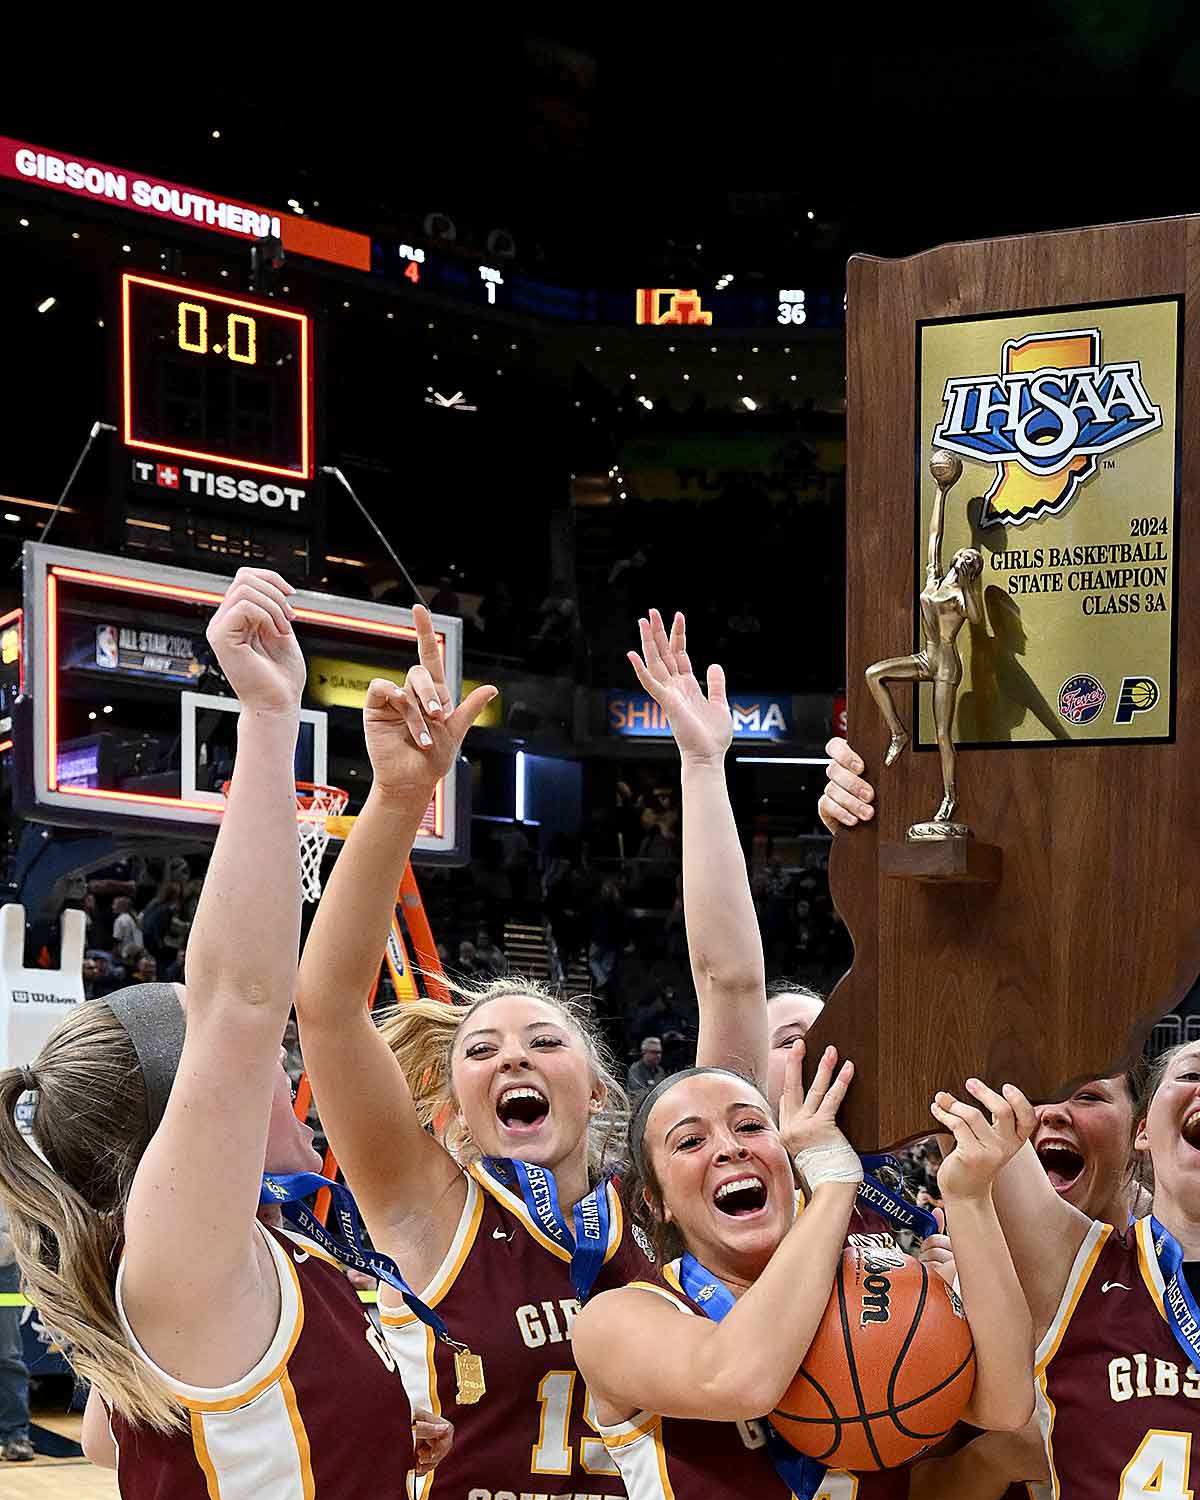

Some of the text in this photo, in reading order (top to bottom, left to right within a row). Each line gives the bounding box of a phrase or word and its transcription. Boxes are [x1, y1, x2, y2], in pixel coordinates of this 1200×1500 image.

[15, 148, 281, 239] GIBSON SOUTHERN
[178, 302, 256, 365] 0.0
[777, 303, 806, 325] 36
[940, 366, 1156, 459] IHSAA
[184, 468, 305, 511] TISSOT
[1130, 517, 1169, 537] 2024
[990, 541, 1168, 572] GIRLS BASKETBALL
[1008, 566, 1168, 595] STATE CHAMPION
[1082, 594, 1168, 617] CLASS 3A
[522, 1161, 563, 1241] ASKETBALL
[857, 1182, 914, 1226] SKETBALL
